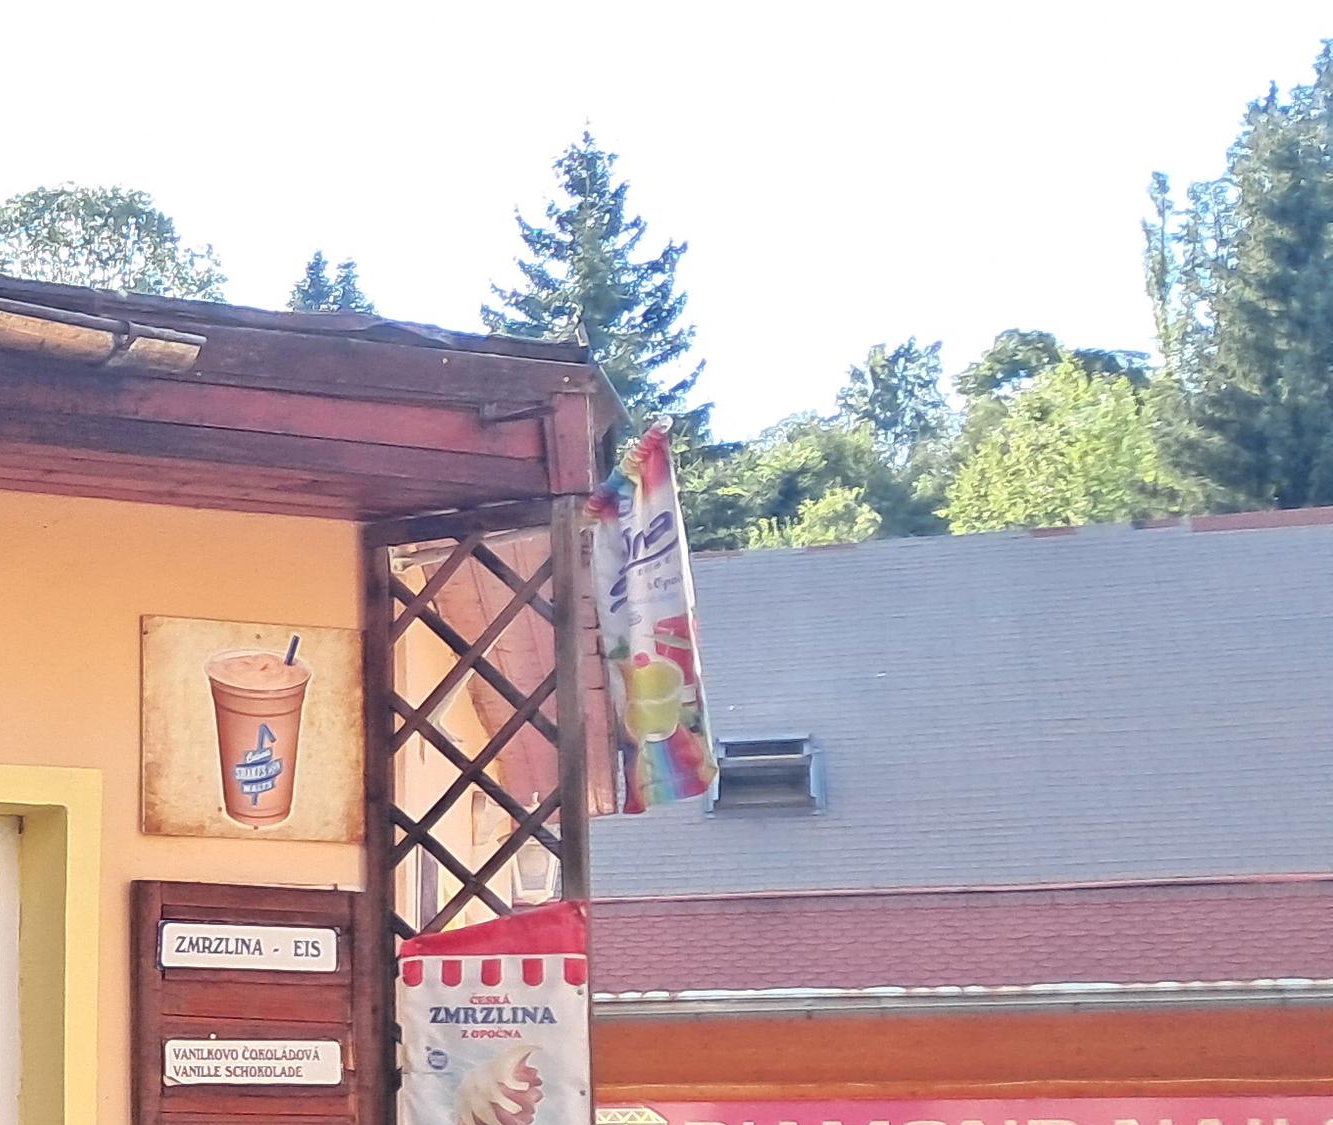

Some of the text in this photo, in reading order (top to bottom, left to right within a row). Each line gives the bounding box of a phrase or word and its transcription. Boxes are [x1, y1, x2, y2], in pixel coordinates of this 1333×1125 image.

[174, 935, 264, 956] ZMRZLINA
[292, 939, 322, 958] EIS
[429, 1006, 558, 1025] ZMRZLINA
[460, 1027, 522, 1039] Z OPOČNA
[172, 1048, 239, 1061] VANILKOVO
[172, 1065, 304, 1079] VANILLE SCHOKOLADE
